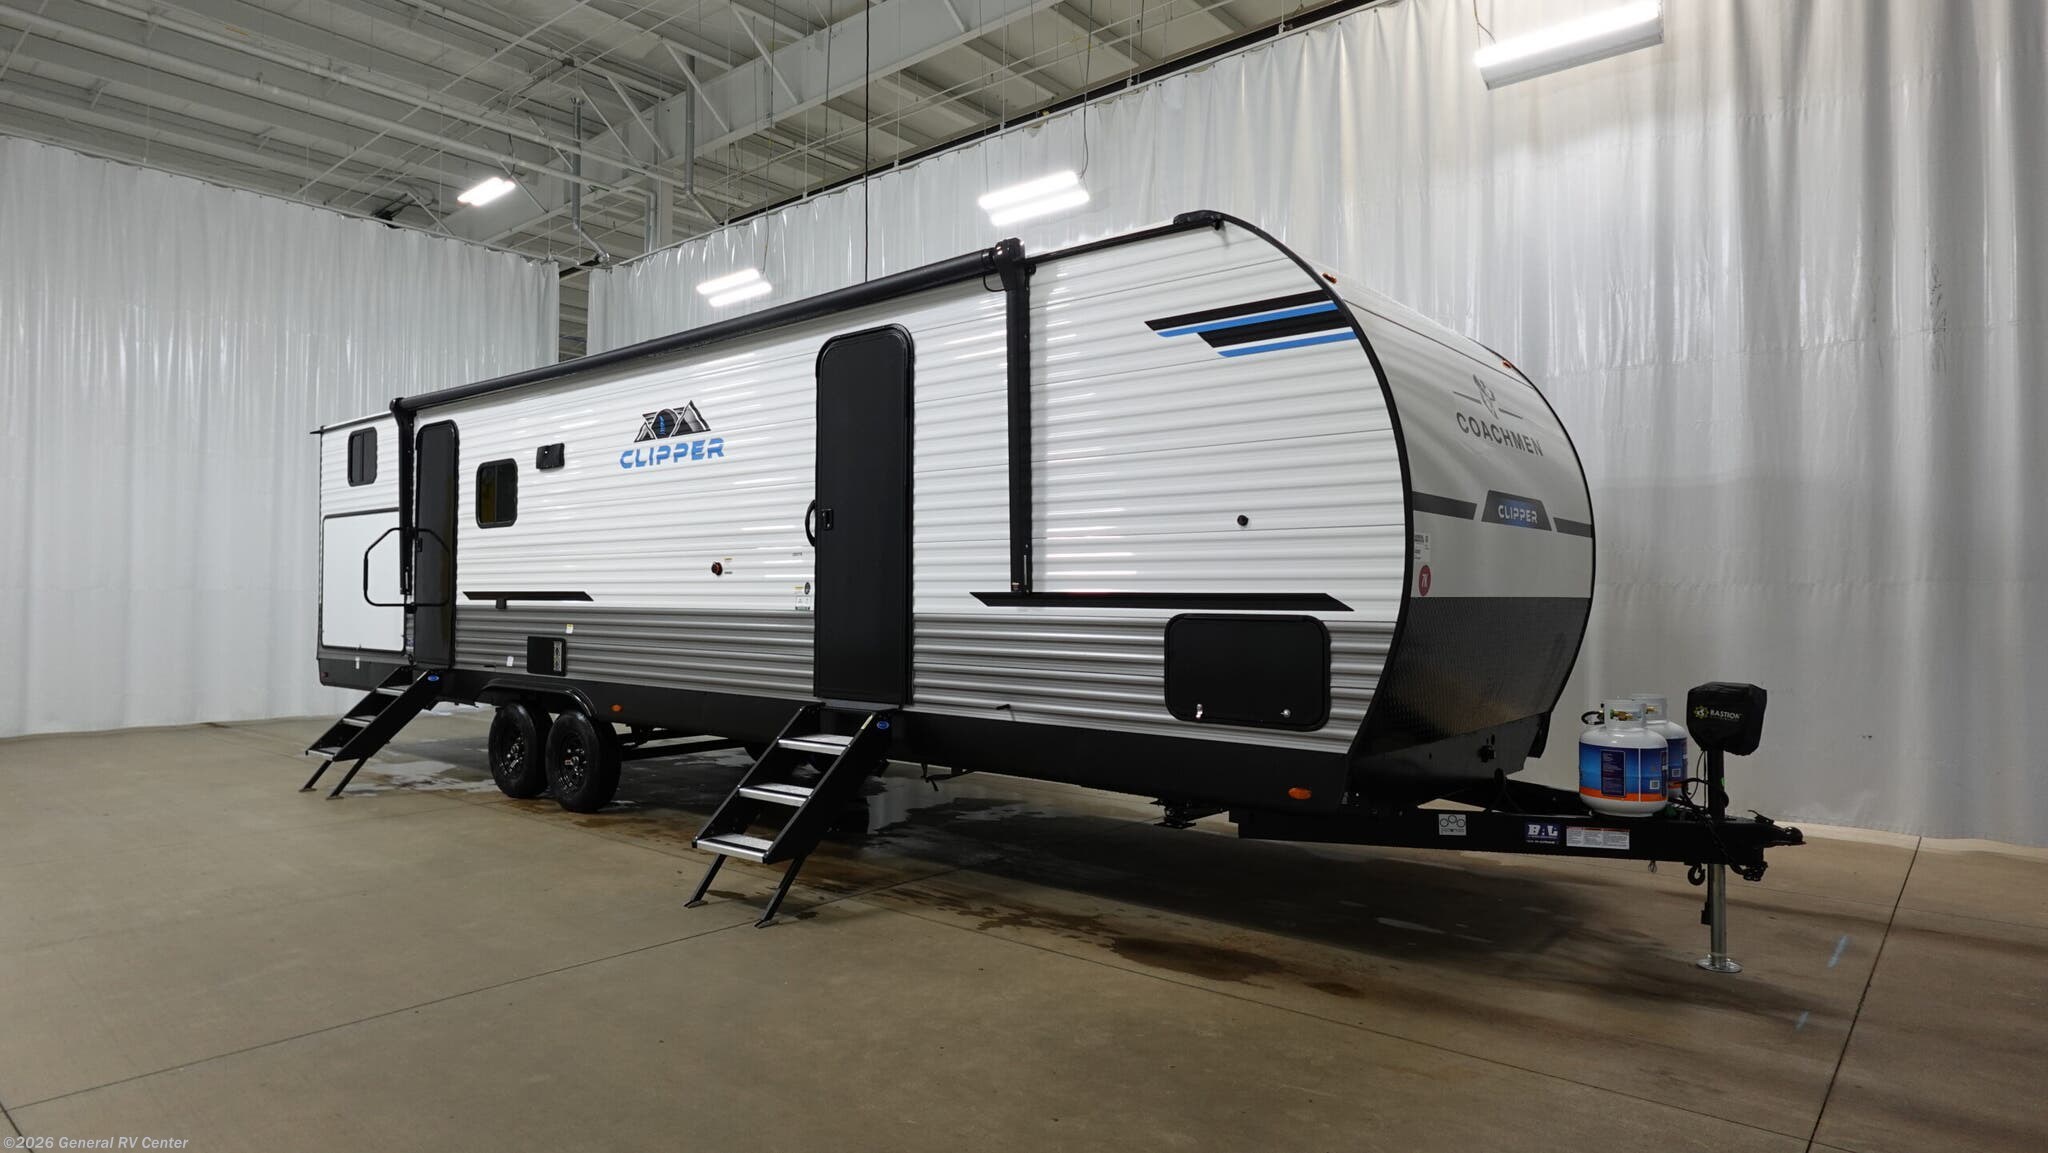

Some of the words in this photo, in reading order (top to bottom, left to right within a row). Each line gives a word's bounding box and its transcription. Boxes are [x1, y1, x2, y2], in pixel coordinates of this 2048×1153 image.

[1456, 411, 1543, 457] COACHMEN
[619, 437, 725, 469] CLIPPER
[1497, 504, 1538, 524] CLIPPER
[1710, 709, 1740, 719] BASTION
